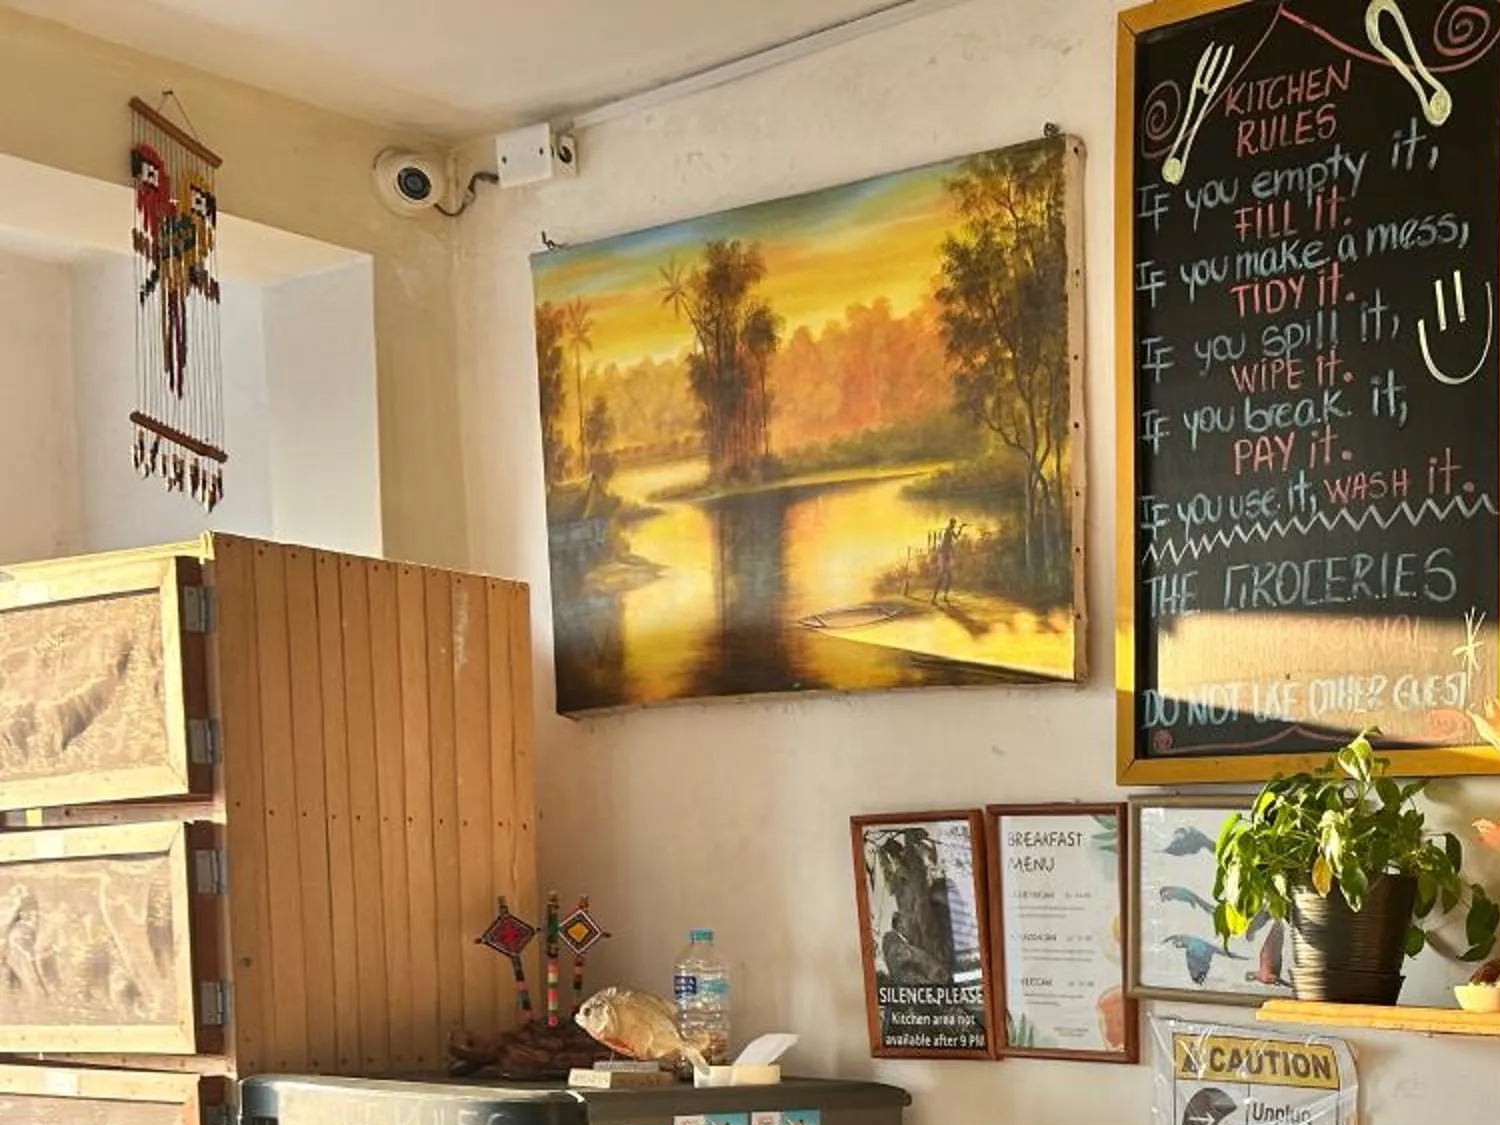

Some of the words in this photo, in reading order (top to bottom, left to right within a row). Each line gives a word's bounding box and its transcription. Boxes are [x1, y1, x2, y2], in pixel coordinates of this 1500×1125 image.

[1224, 59, 1351, 118] KITCHEN
[1237, 104, 1337, 158] RULES
[1251, 143, 1369, 208] empty
[1234, 431, 1295, 476] PAY
[1324, 468, 1408, 504] WASH
[1143, 571, 1199, 618] THE
[1222, 547, 1458, 612] GROCERIES
[1186, 682, 1249, 728] NOT
[1008, 831, 1083, 847] BREAKFAST
[1209, 1046, 1332, 1080] CAUTION
